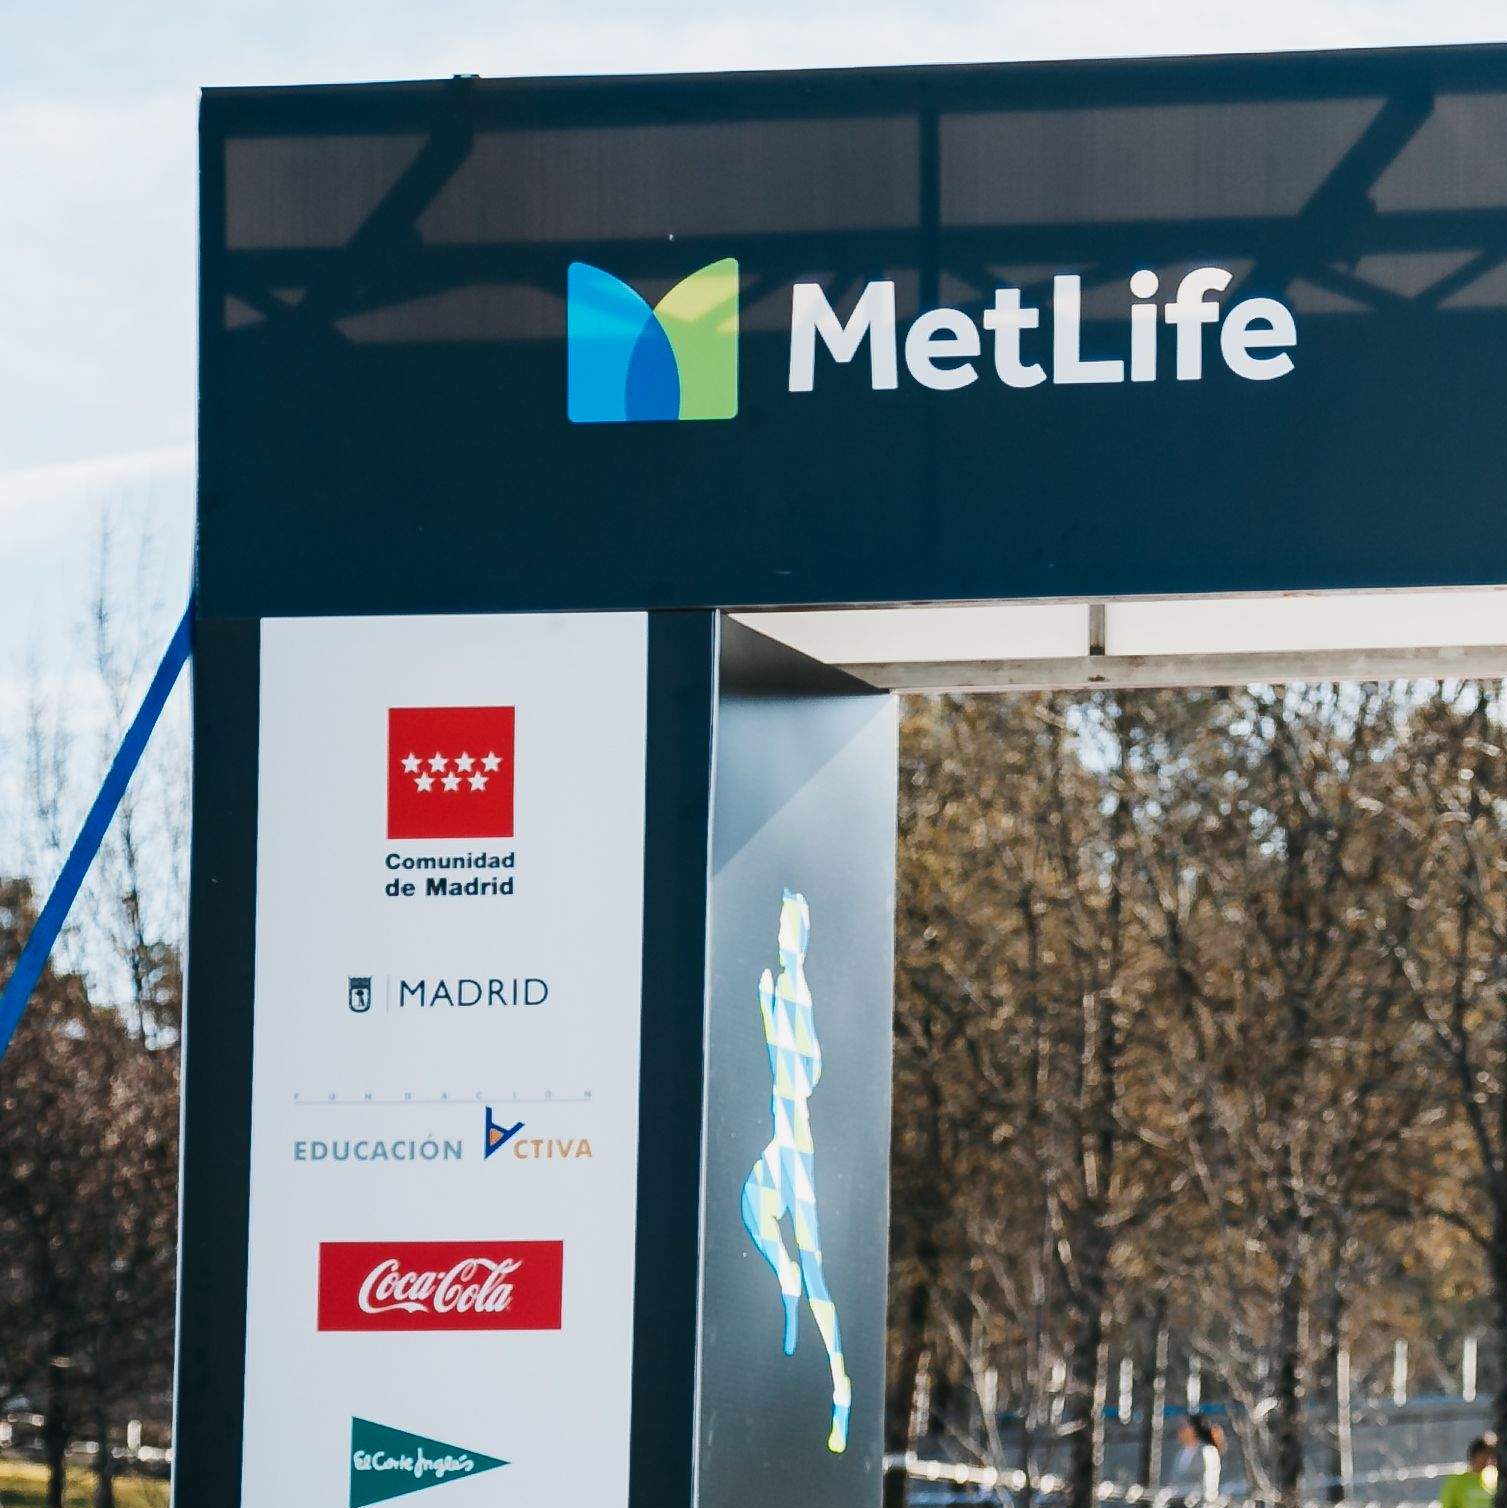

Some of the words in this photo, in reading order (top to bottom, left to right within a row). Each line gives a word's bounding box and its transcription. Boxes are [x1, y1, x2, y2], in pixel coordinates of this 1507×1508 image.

[788, 265, 1297, 393] MetLife
[385, 852, 516, 869] Comunidad
[385, 879, 416, 897] de
[426, 877, 515, 896] Madrid
[399, 978, 549, 1008] MADRID
[293, 1133, 463, 1162] EDUCACIÓN
[358, 1258, 525, 1314] Coca-Cola
